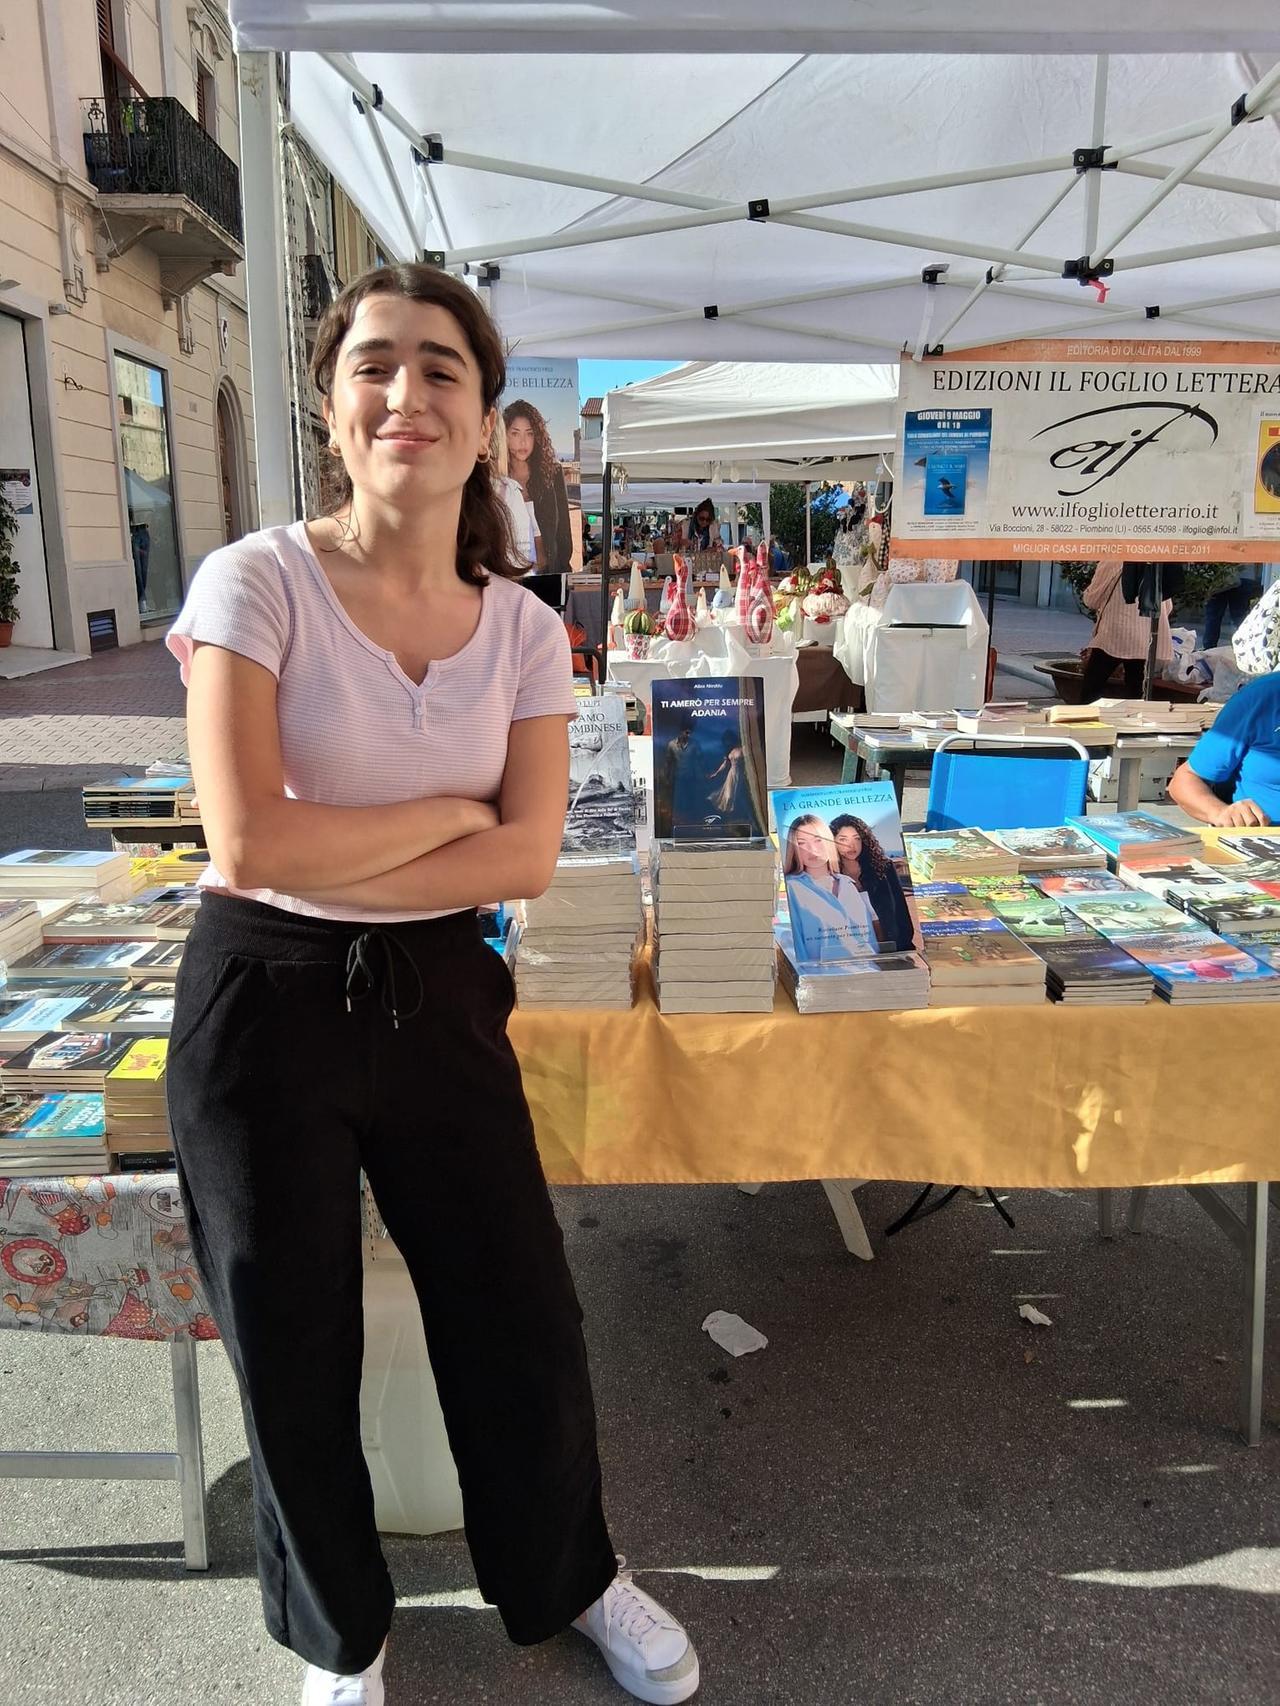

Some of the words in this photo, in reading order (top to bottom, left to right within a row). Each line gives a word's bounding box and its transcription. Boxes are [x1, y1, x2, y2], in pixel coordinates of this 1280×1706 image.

[1067, 344, 1110, 356] EDITORIA
[1111, 346, 1122, 356] DI
[1163, 346, 1181, 357] DAL
[1182, 347, 1202, 357] 1999
[522, 377, 574, 388] BELLEZZA
[932, 369, 1042, 392] EDIZIONI
[1048, 370, 1072, 392] IL
[1079, 370, 1168, 393] FOGLIO
[952, 410, 981, 420] MAGGIO
[1011, 501, 1219, 522] www.ilfoglioletterario.it
[989, 523, 1001, 532] Via
[1036, 524, 1045, 533] 28
[1050, 524, 1073, 533] 58022
[1080, 524, 1114, 533] Piombino
[1012, 543, 1050, 554] MIGLIOR
[1052, 544, 1078, 554] CASA
[1079, 544, 1123, 554] EDITRICE
[1125, 544, 1171, 555] TOSCANA
[1172, 544, 1190, 555] DEL
[1191, 544, 1210, 555] 2011
[660, 700, 669, 708] TI
[670, 697, 703, 708] AMERÒ
[704, 698, 720, 707] PER
[721, 698, 755, 707] SEMPRE
[691, 709, 727, 717] ADANIA
[783, 801, 797, 811] LA
[799, 797, 842, 810] GRANDE
[844, 792, 893, 806] BELLEZZA
